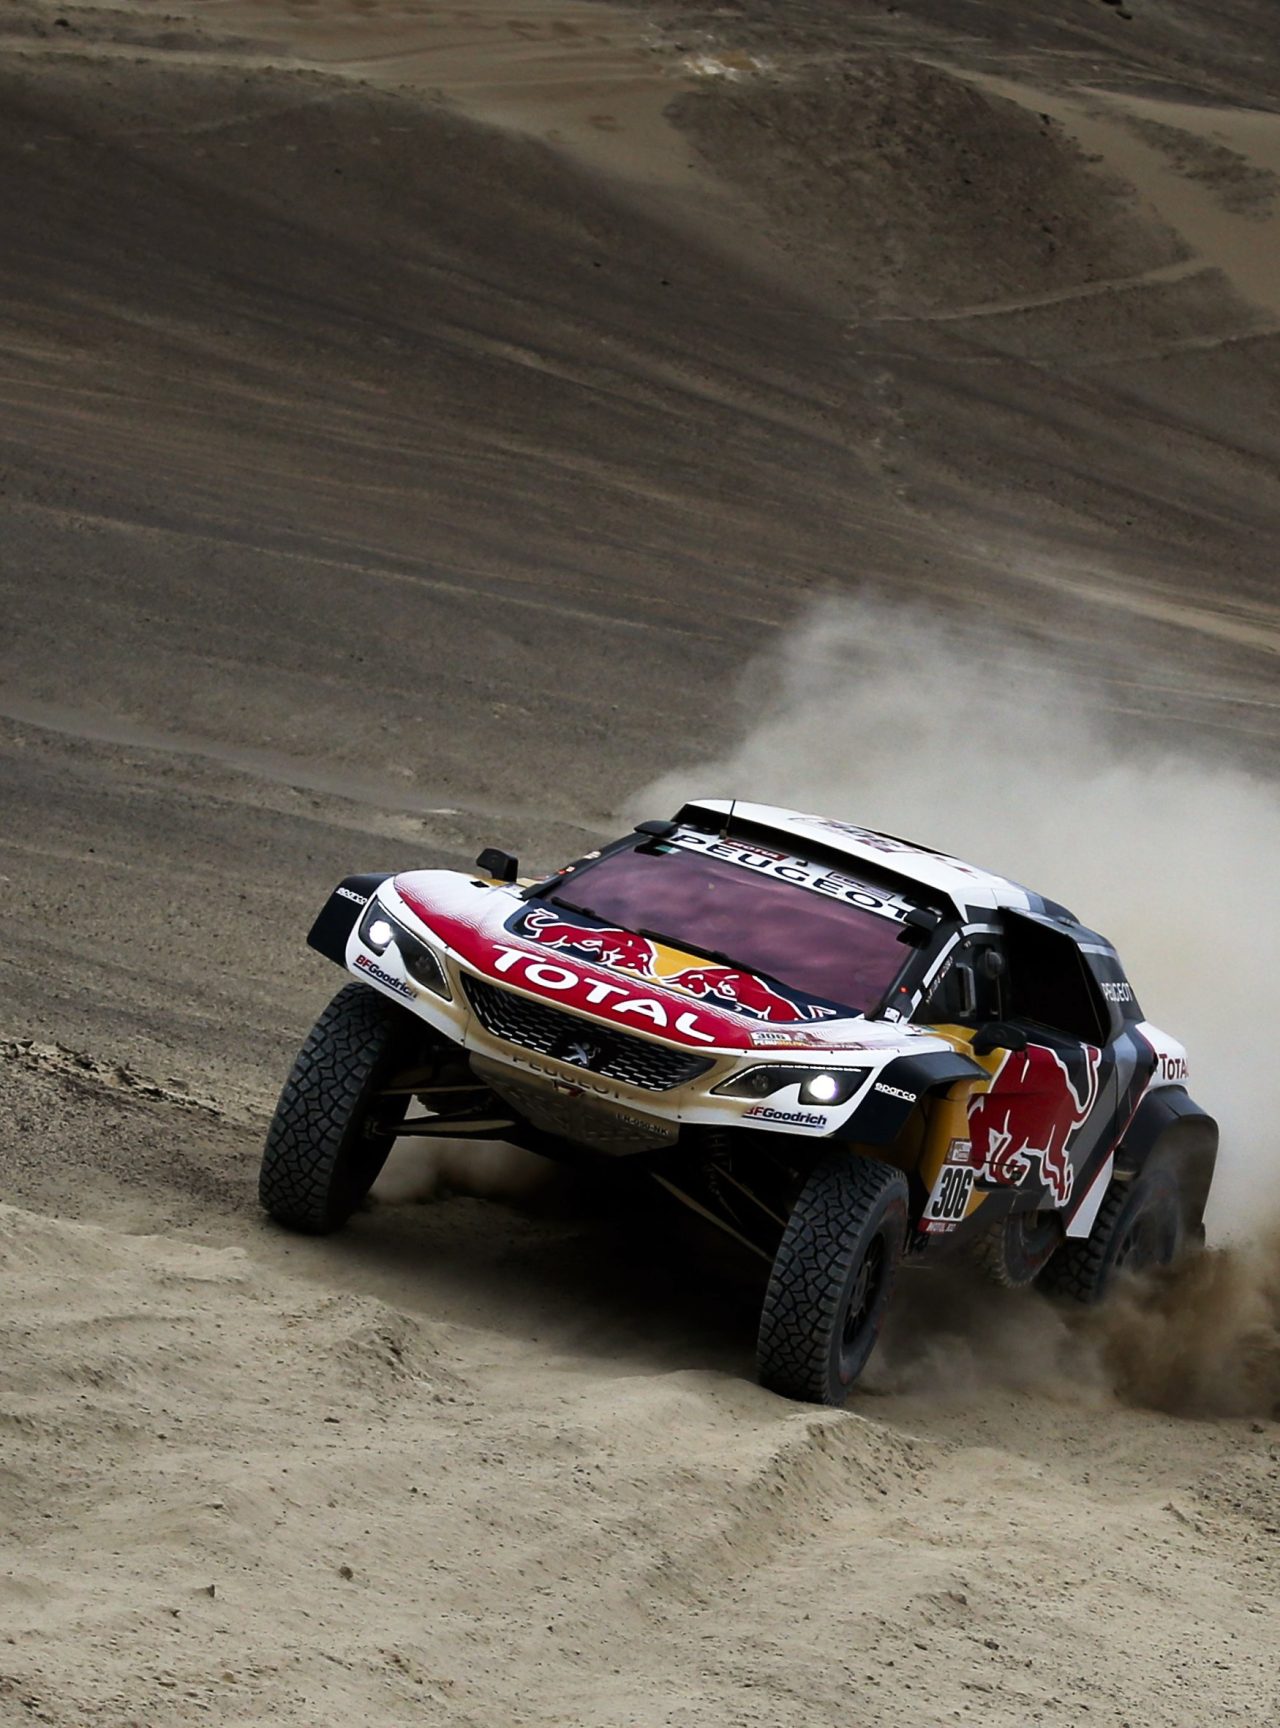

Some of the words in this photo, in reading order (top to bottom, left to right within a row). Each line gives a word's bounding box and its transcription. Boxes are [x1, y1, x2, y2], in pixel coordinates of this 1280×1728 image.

[672, 834, 910, 919] PEUGEOT
[355, 954, 418, 998] BFGoodrich
[492, 944, 716, 1043] TOTAL
[1158, 1053, 1189, 1080] TOTA
[874, 1082, 917, 1102] sparco
[931, 1168, 973, 1218] 306
